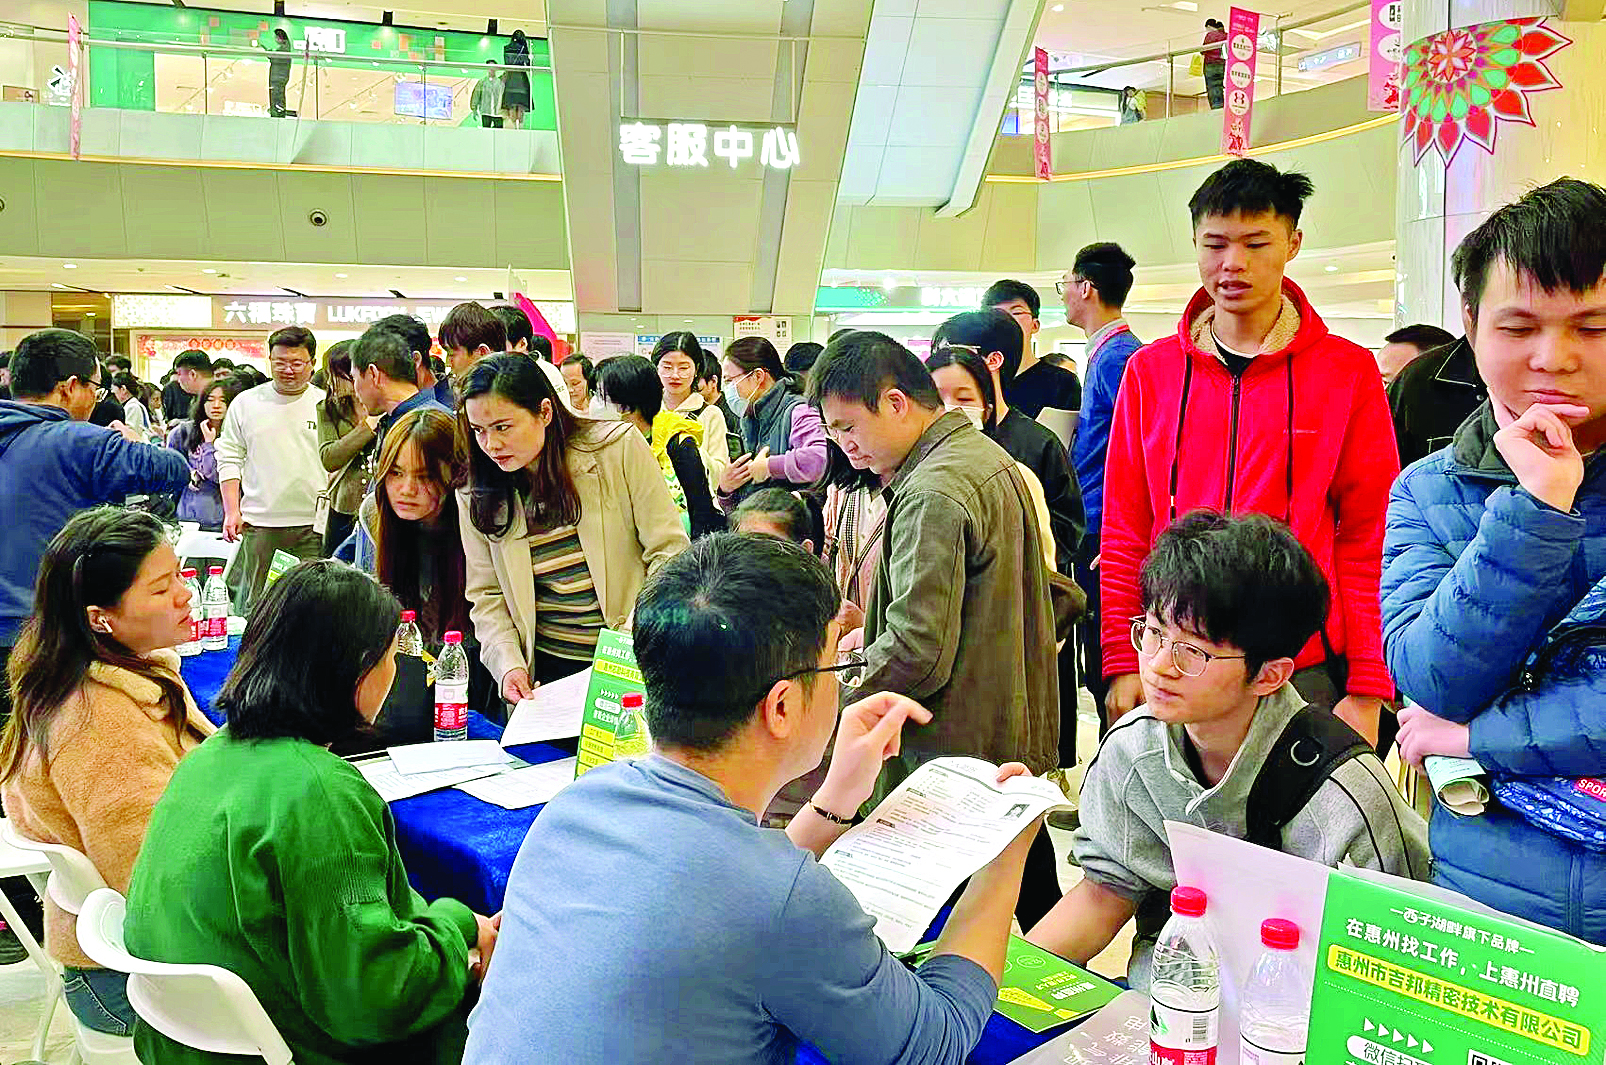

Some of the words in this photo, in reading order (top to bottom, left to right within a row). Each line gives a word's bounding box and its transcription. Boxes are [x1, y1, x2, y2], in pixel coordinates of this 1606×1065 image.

[619, 121, 800, 169] 客服中心
[1335, 950, 1582, 1048] 惠州市吉邦精密技术有限公司
[1364, 1042, 1427, 1065] 微信扫
